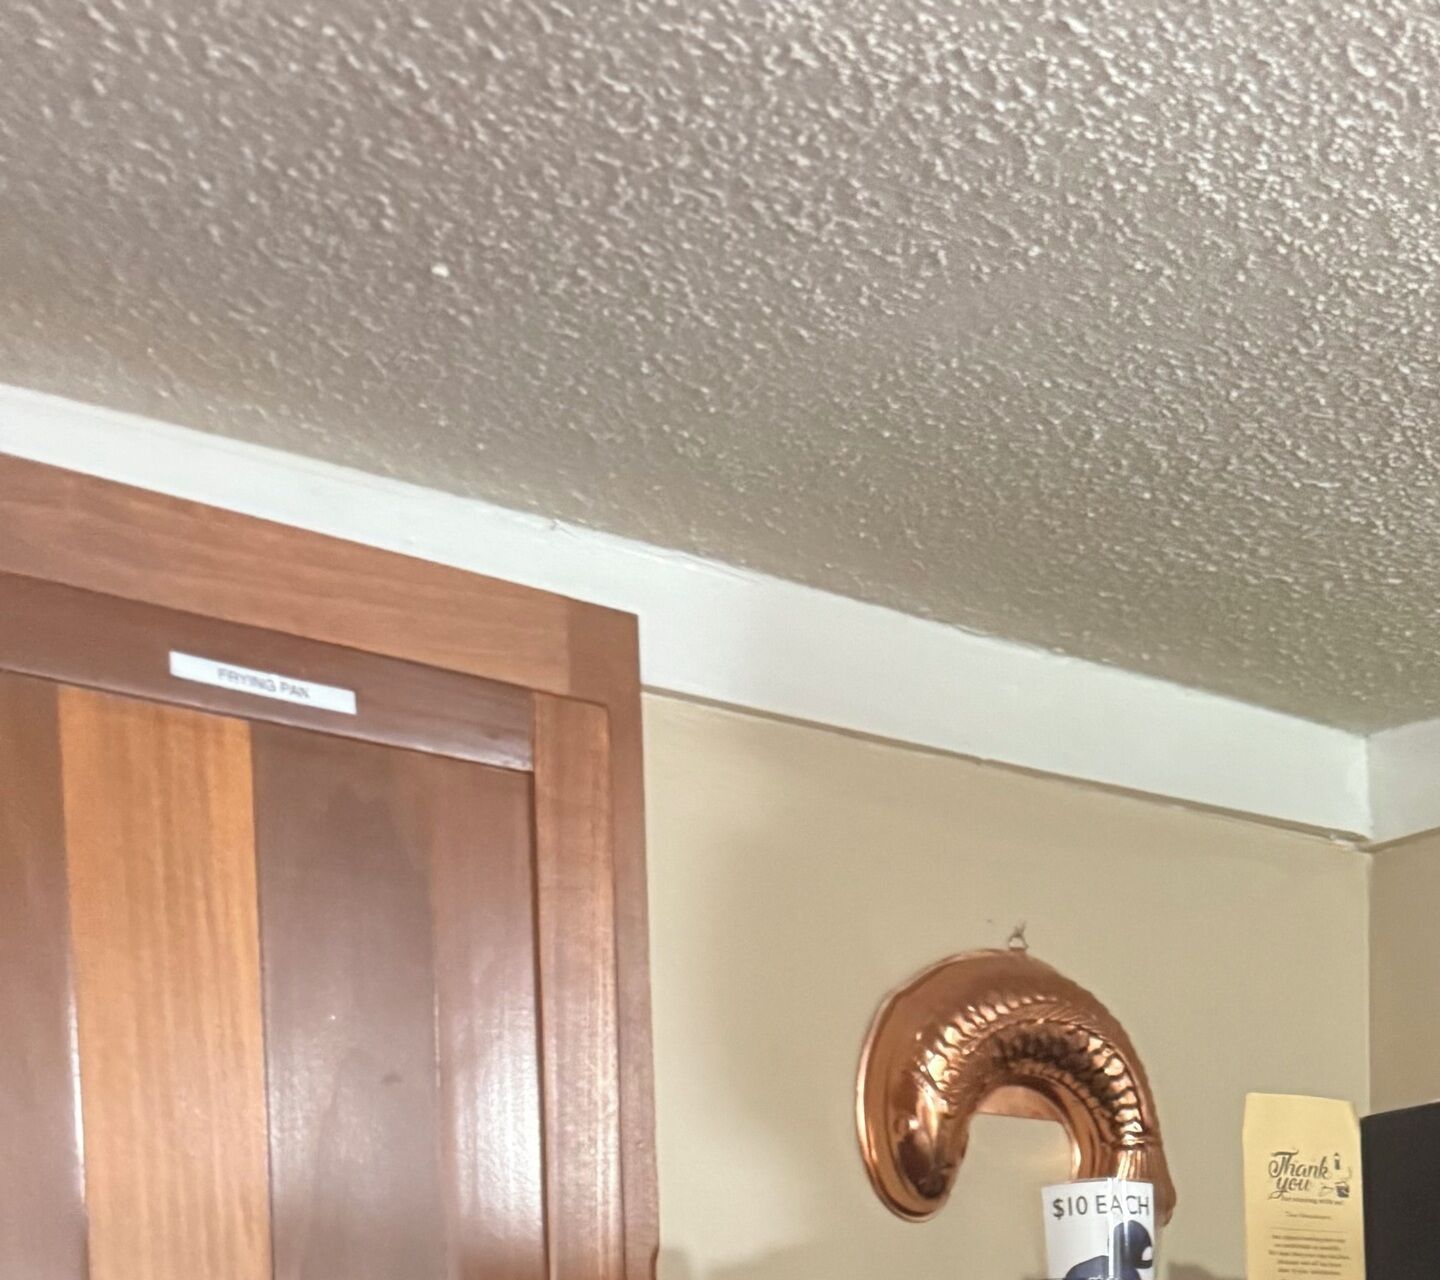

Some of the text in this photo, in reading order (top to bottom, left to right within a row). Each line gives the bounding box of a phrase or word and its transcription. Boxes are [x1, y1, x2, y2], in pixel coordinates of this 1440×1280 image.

[1268, 1150, 1329, 1179] Thank
[1268, 1177, 1310, 1200] you
[1052, 1195, 1149, 1219] $10 EACH
